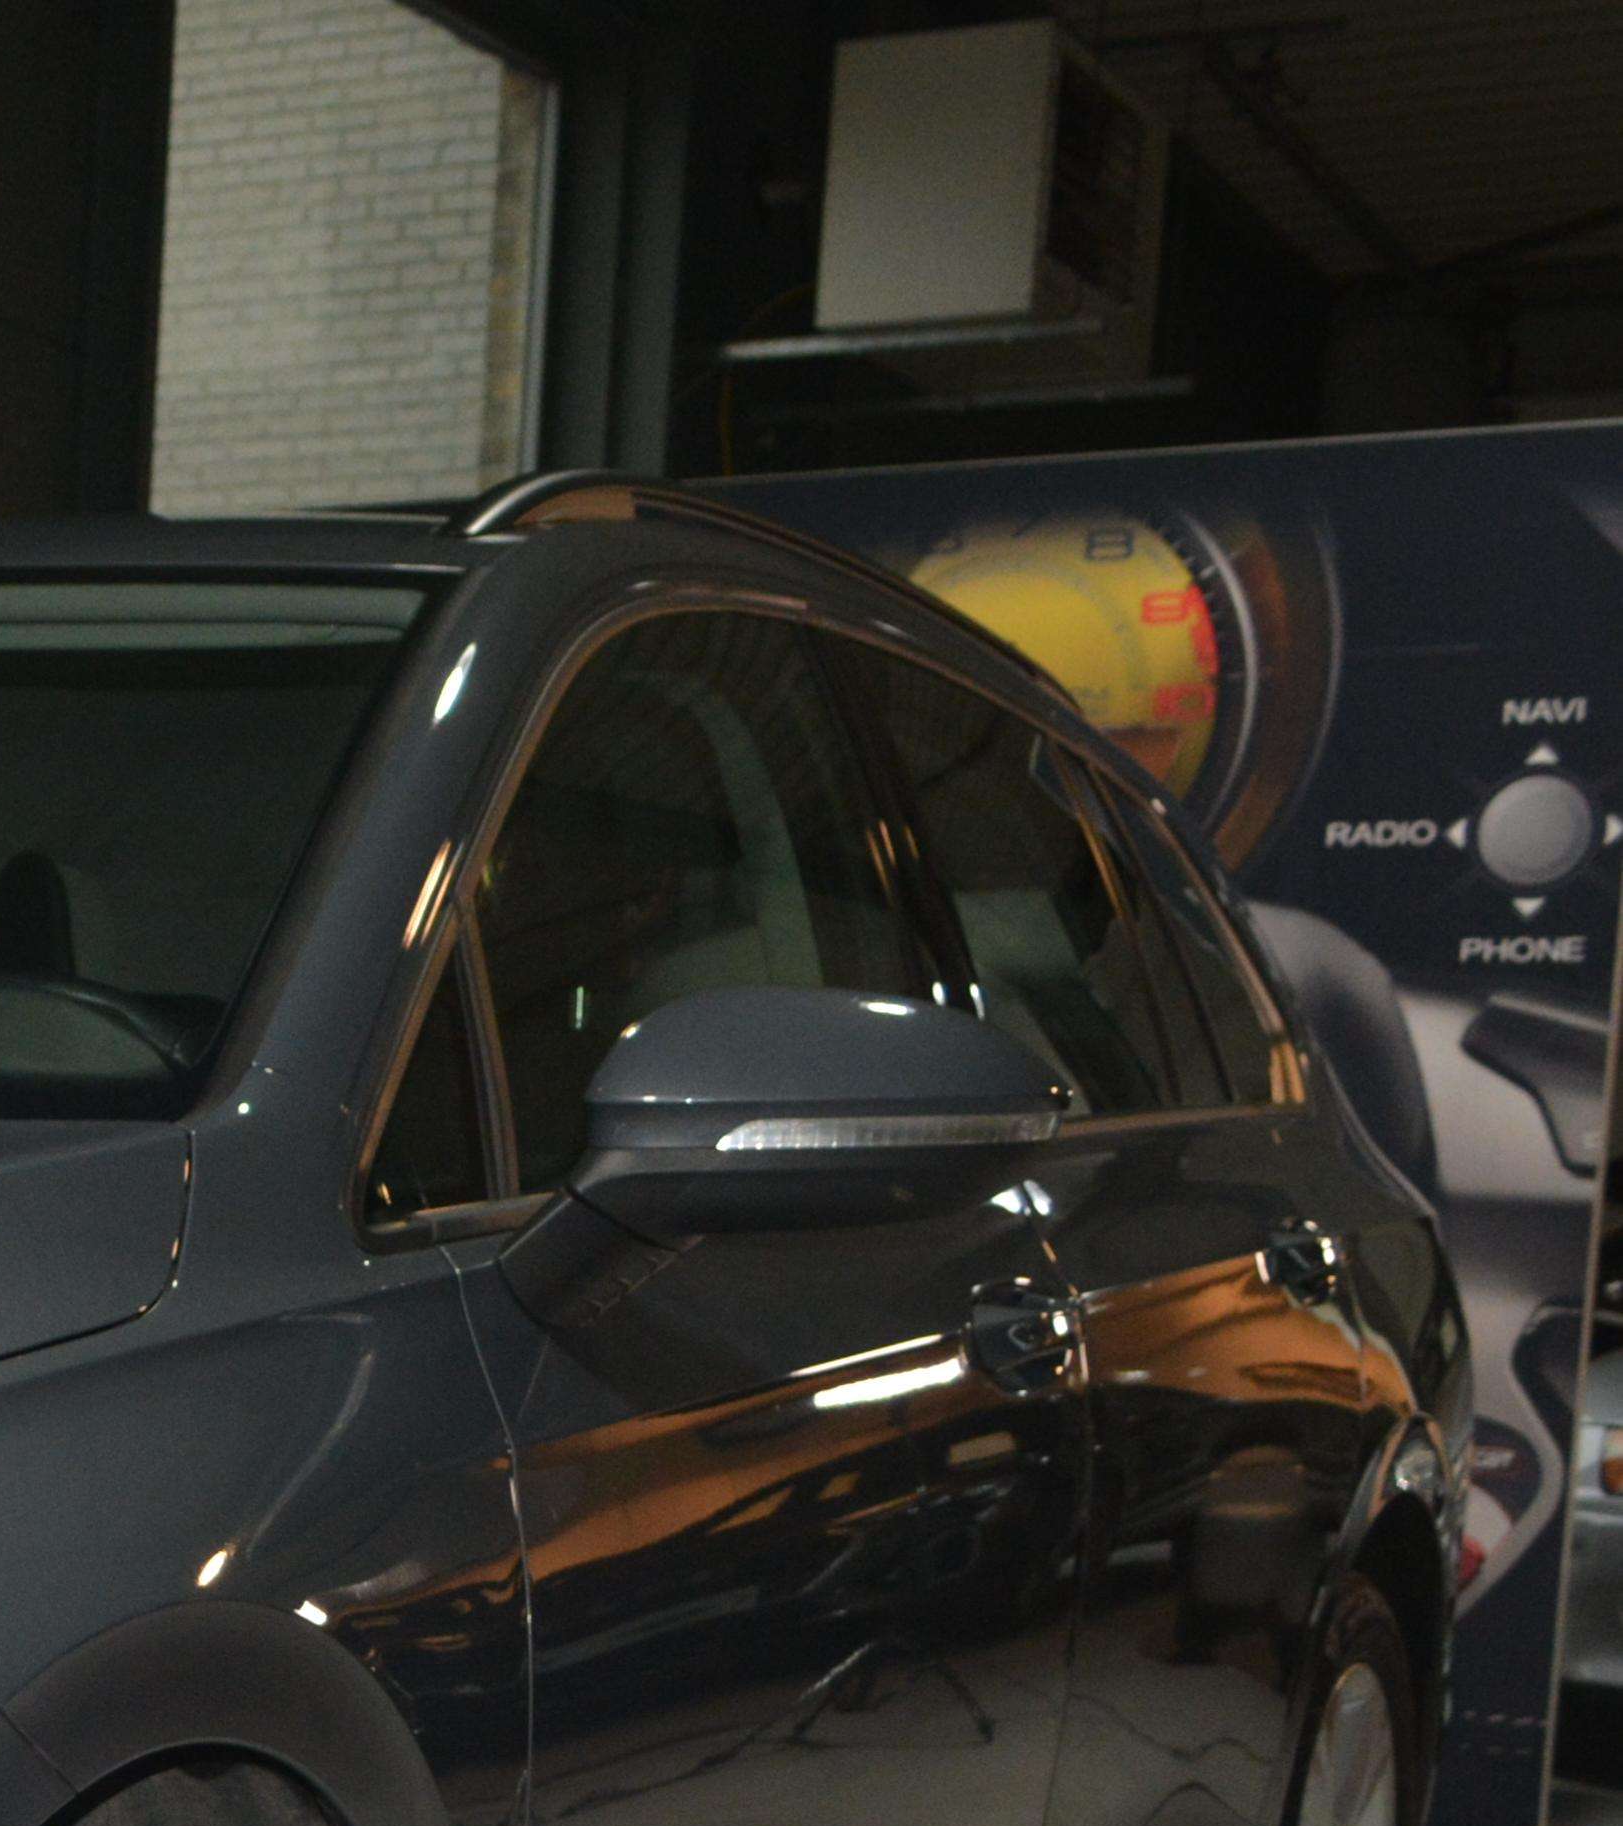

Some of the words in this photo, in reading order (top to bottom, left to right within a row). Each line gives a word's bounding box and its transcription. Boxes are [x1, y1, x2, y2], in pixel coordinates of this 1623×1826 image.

[1502, 699, 1588, 725] NAVI
[1325, 820, 1437, 847] RADIO
[1459, 936, 1587, 964] PHONE
